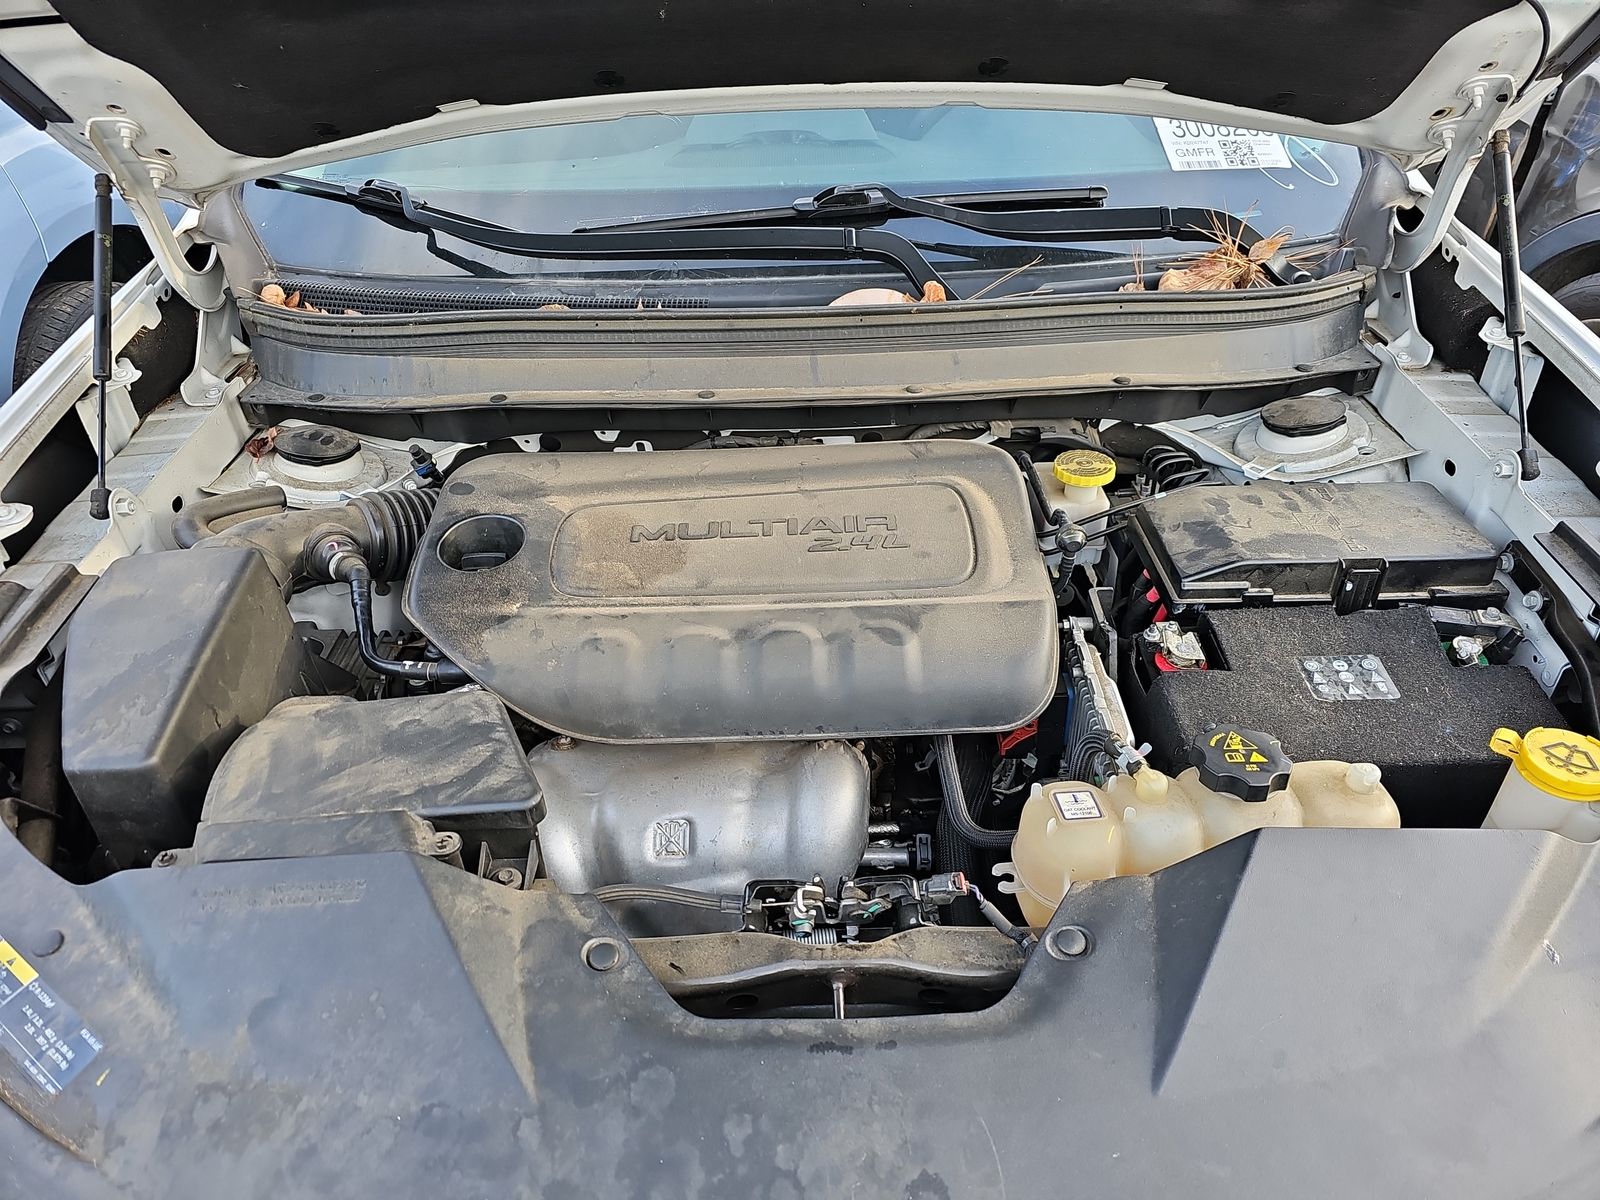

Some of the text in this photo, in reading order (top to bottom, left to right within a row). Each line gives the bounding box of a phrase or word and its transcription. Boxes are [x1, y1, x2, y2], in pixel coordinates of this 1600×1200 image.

[1175, 147, 1216, 158] GMFR
[630, 514, 898, 543] MULTIAIR
[808, 533, 910, 552] 2.4L
